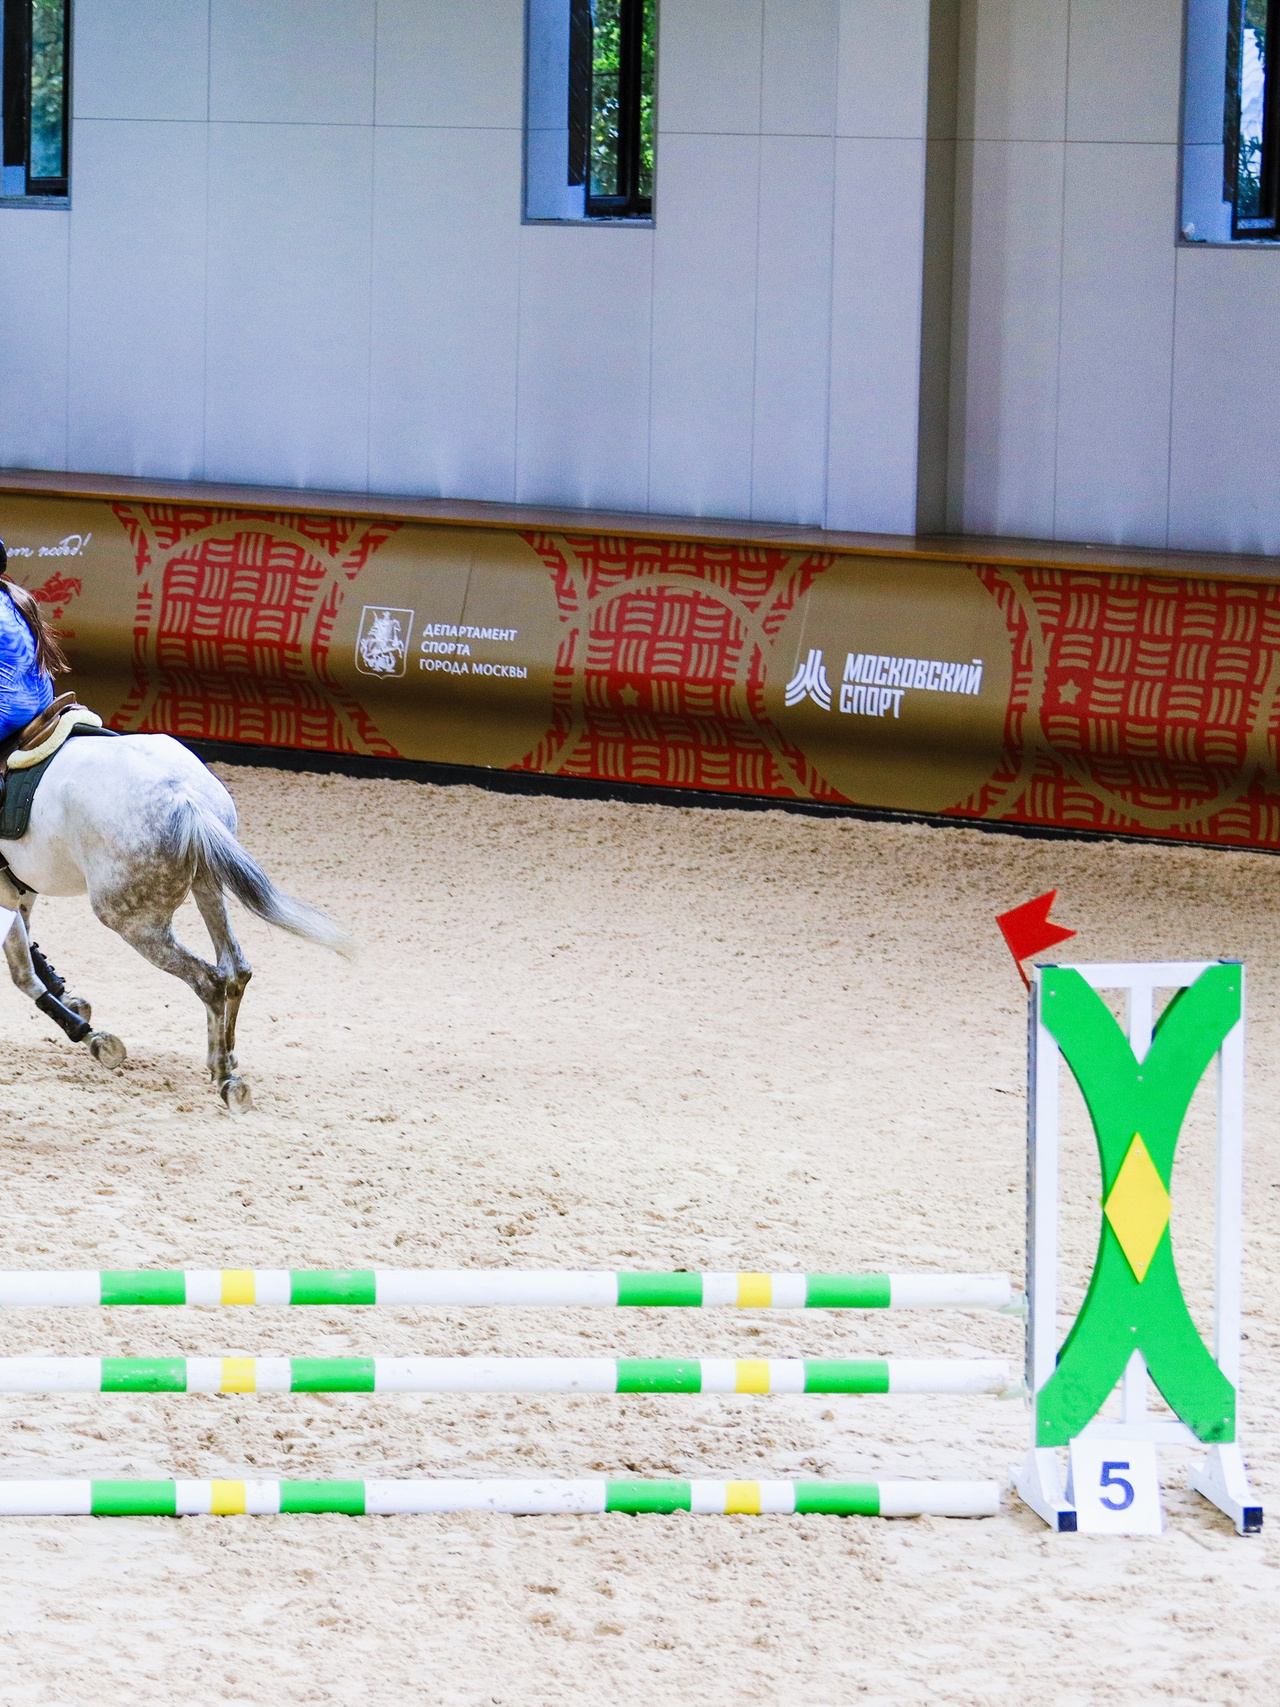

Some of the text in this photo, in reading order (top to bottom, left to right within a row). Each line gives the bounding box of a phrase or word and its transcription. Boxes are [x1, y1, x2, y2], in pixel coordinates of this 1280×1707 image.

[422, 623, 518, 641] ДЕПАРТАМЕНТ
[420, 641, 471, 656] СПОРТА
[419, 658, 528, 678] ГОРОДА МОСКВЫ
[843, 652, 984, 695] МОСКОВСКИЙ
[839, 683, 906, 719] СПОРТ
[1099, 1461, 1135, 1511] 5
